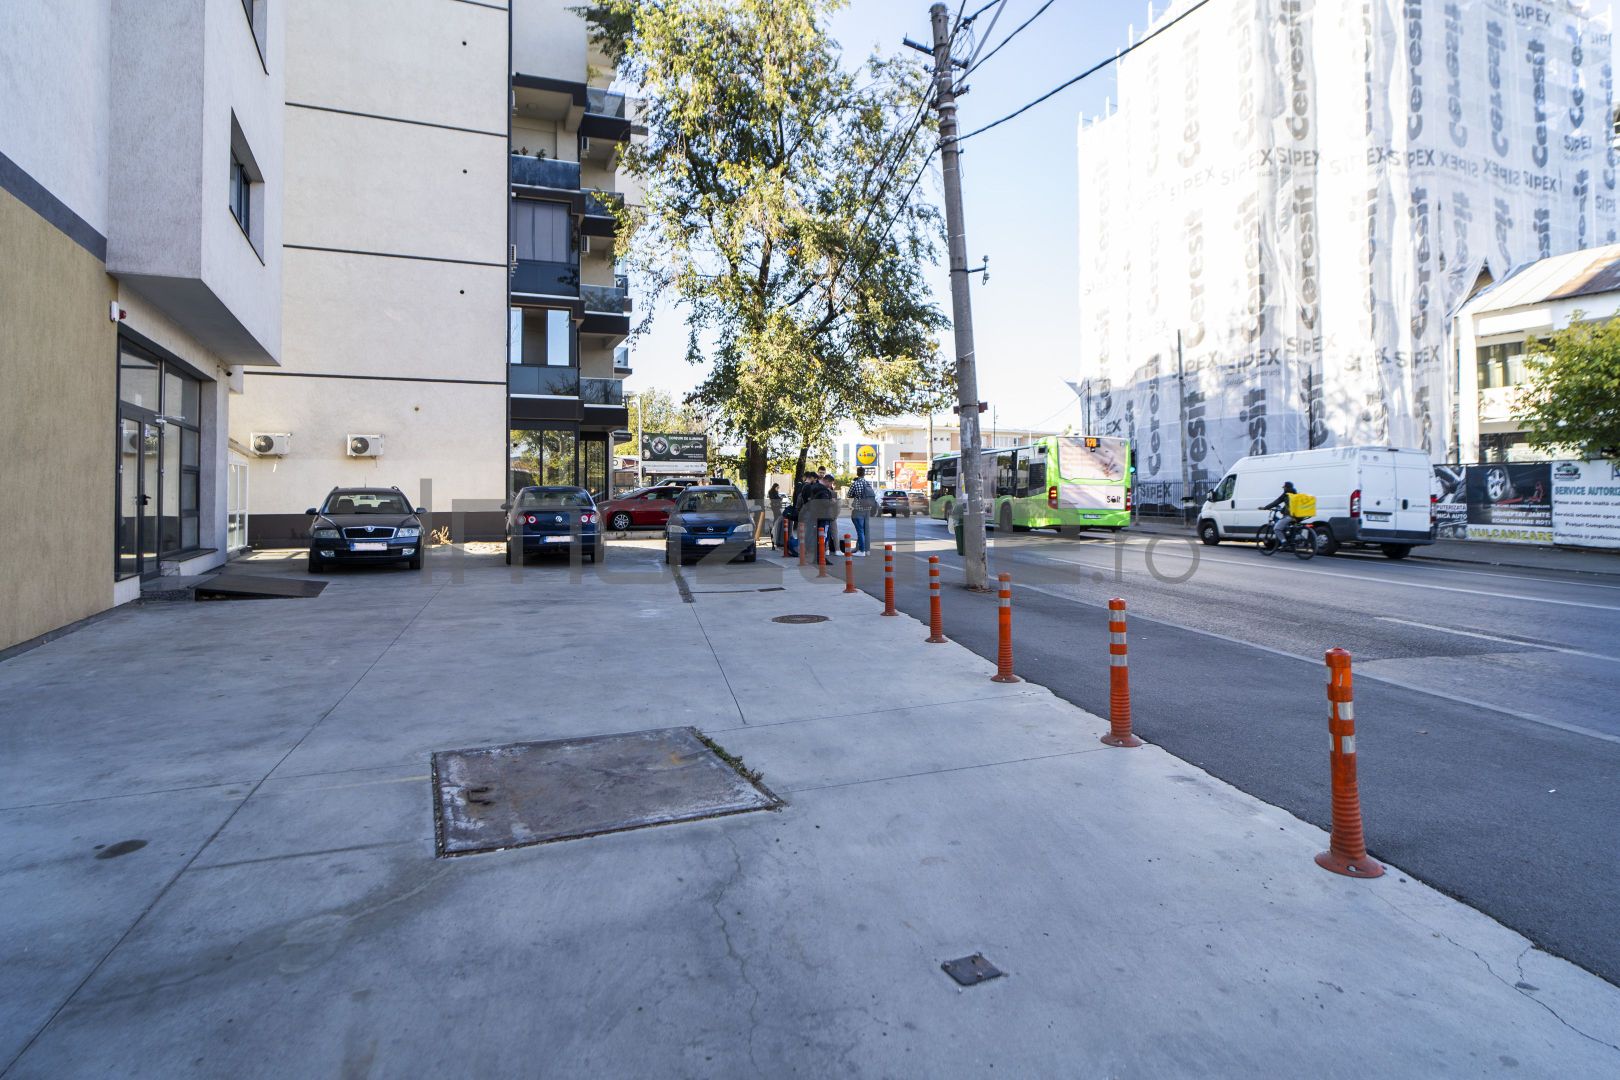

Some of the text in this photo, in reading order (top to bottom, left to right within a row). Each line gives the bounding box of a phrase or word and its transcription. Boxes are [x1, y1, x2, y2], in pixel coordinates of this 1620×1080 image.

[1526, 38, 1548, 169] Ceresit
[1293, 186, 1319, 331] Ceresit
[1555, 486, 1586, 495] SERVICE
[1469, 527, 1553, 542] VULCANIZARE
